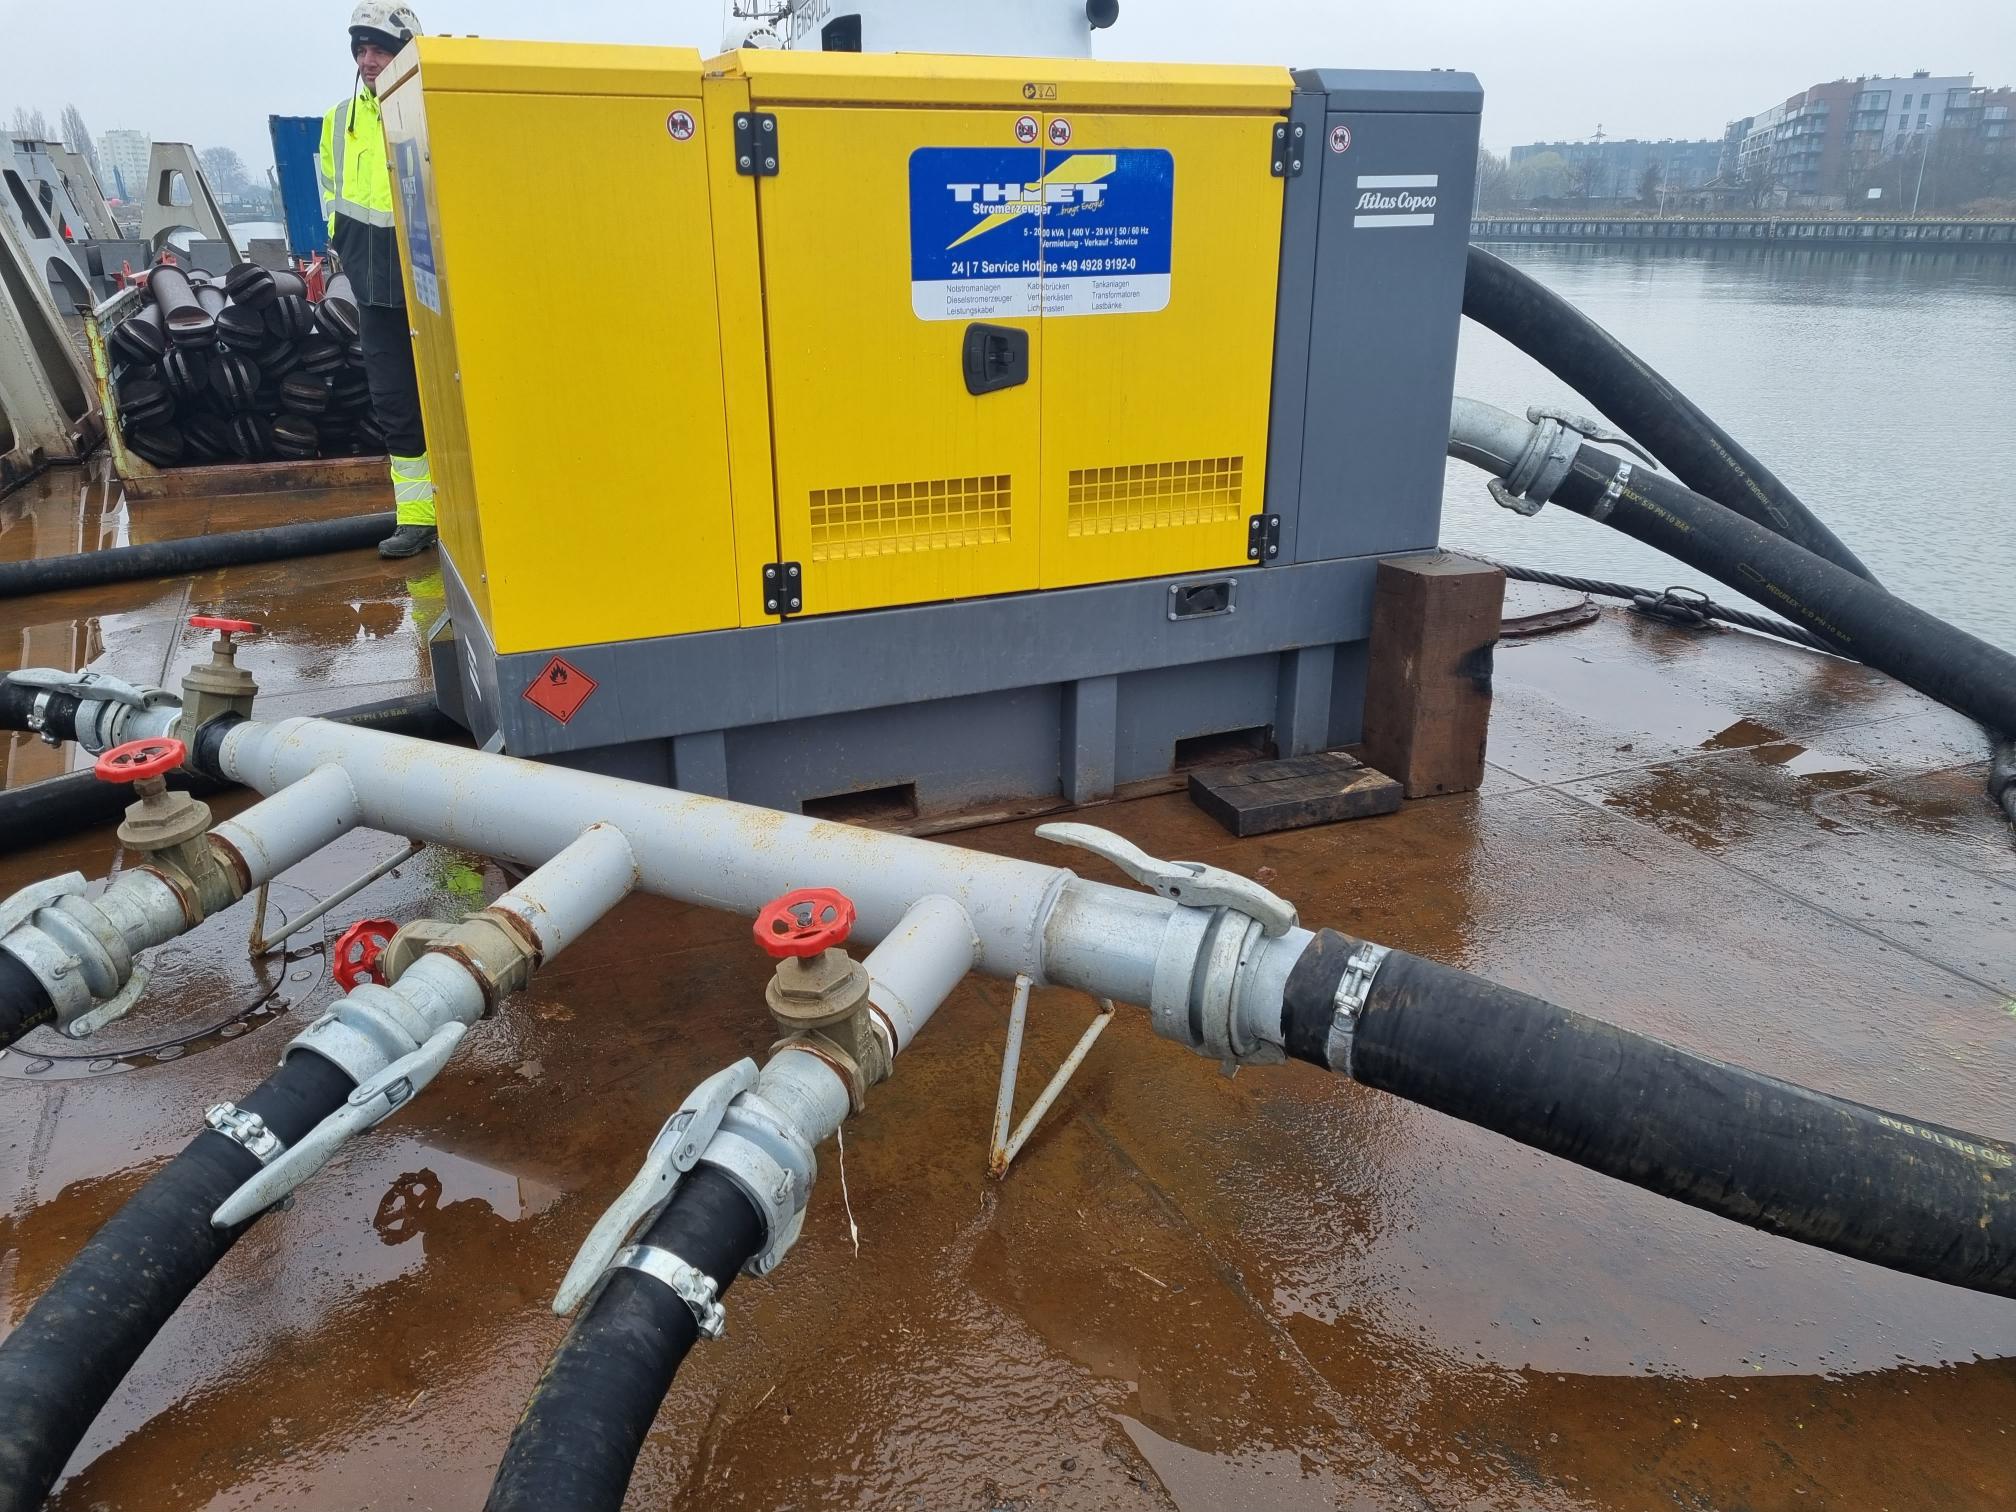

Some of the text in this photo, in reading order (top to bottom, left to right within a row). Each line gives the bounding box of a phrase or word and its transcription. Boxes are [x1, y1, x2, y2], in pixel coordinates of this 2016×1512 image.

[1354, 191, 1437, 212] Atlas Copco
[973, 202, 1052, 216] Stromerzeuger
[1023, 227, 1029, 238] 5
[1033, 227, 1050, 238] 2000
[1051, 228, 1065, 238] kVA
[1071, 227, 1084, 237] 400
[1084, 227, 1091, 236] V
[1095, 227, 1104, 237] 20
[1104, 226, 1114, 236] kV
[1118, 226, 1127, 236] 50
[1131, 226, 1140, 236] 60
[1140, 226, 1149, 235] Hz
[1084, 237, 1109, 247] Verkauf
[1114, 237, 1138, 246] Service
[951, 262, 963, 274] 24
[973, 262, 978, 273] 7
[982, 261, 1019, 273] Service
[1022, 259, 1058, 273] Hotine
[1060, 259, 1078, 272] +49
[1080, 258, 1103, 271] 4928
[1105, 257, 1136, 270] 9192-0
[946, 284, 1002, 294] Notstromanlagen
[1027, 282, 1070, 291] Kablbrücken
[1091, 280, 1130, 290] Tankanlagen
[946, 295, 1013, 304] Dieselstromerzeuger
[1091, 290, 1141, 300] Transformatoren
[946, 305, 995, 317] Leistungskabel
[1027, 303, 1065, 312] Lichmasten
[560, 710, 566, 718] 3
[1877, 1114, 1915, 1135] BAR
[1920, 1128, 1943, 1144] 10
[1949, 1138, 1976, 1155] PN
